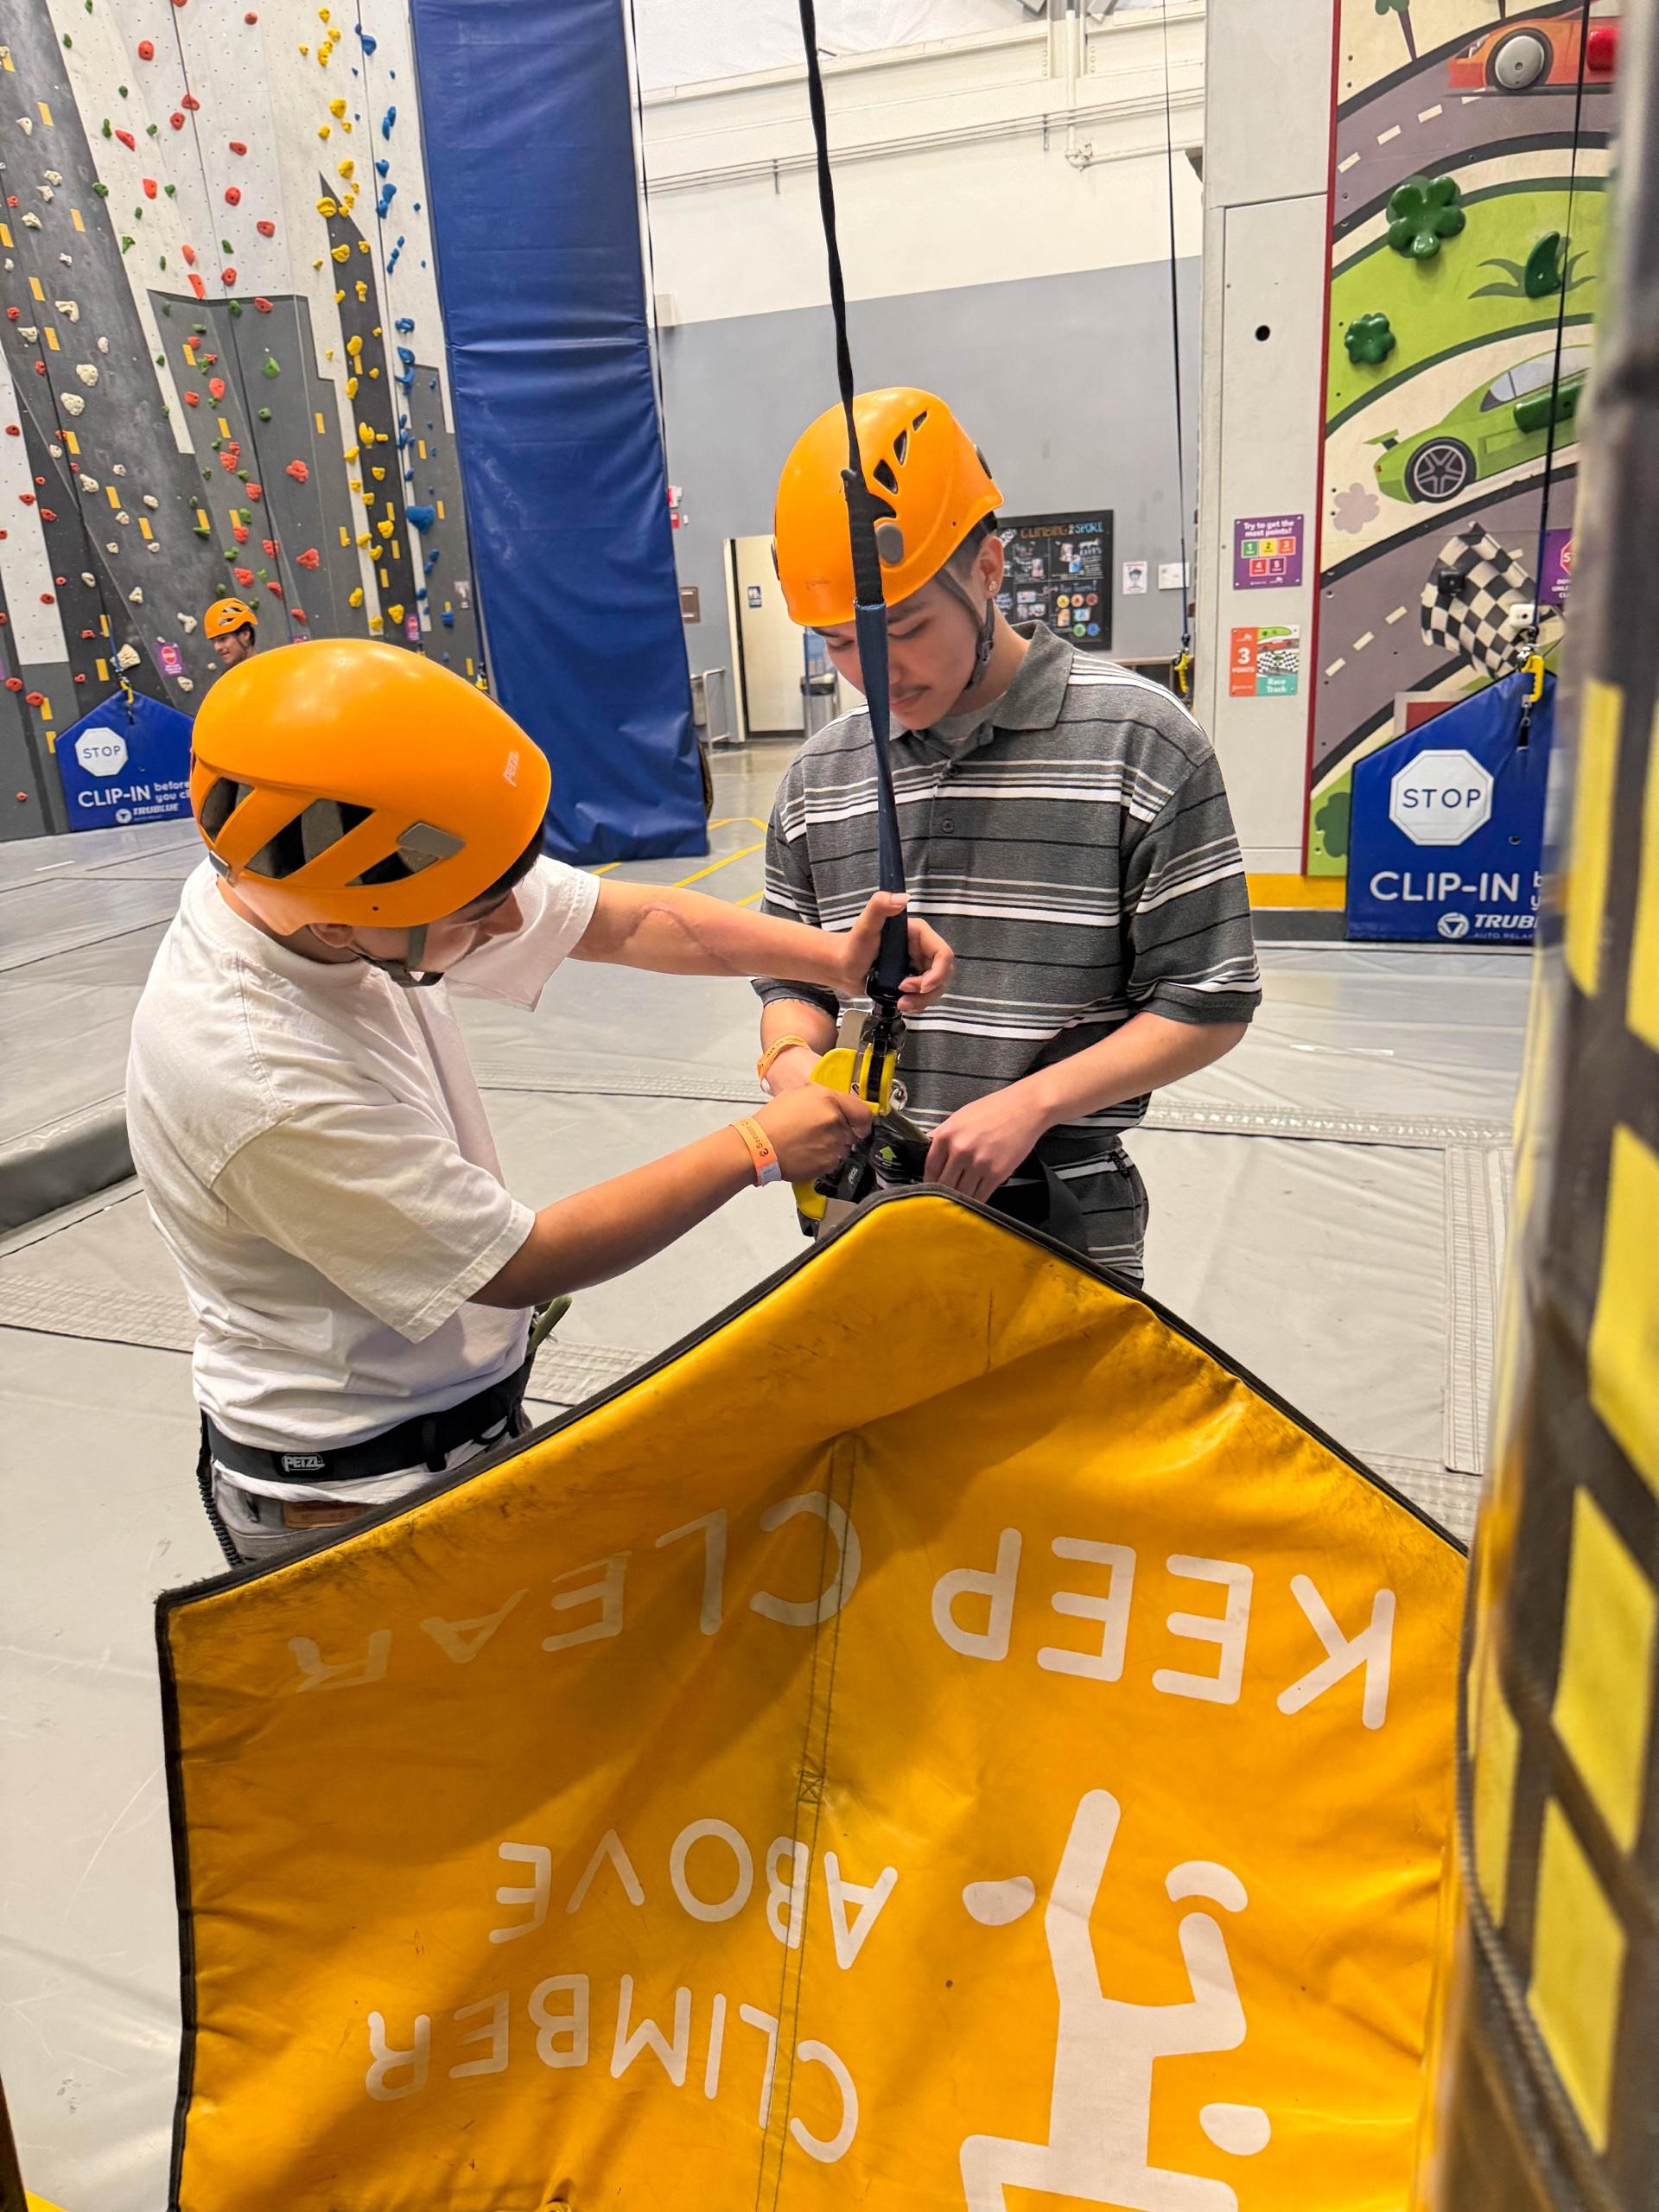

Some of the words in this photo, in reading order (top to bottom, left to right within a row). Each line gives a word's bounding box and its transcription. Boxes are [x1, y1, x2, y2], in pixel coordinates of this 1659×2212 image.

[1243, 522, 1255, 531] Try
[1267, 521, 1280, 530] get
[1265, 527, 1293, 537] points!
[1237, 647, 1250, 664] 3
[83, 745, 121, 759] STOP
[78, 785, 151, 807] CLIP-IN
[156, 793, 177, 804] you
[1402, 788, 1481, 809] STOP
[1370, 871, 1520, 902] CLIP-IN
[283, 1454, 326, 1472] PETZL
[288, 1491, 861, 1694] CLEAR
[931, 1527, 1396, 1731] KEEP
[489, 1818, 899, 1970] ABOVE
[365, 1974, 859, 2164] CLIMBER
